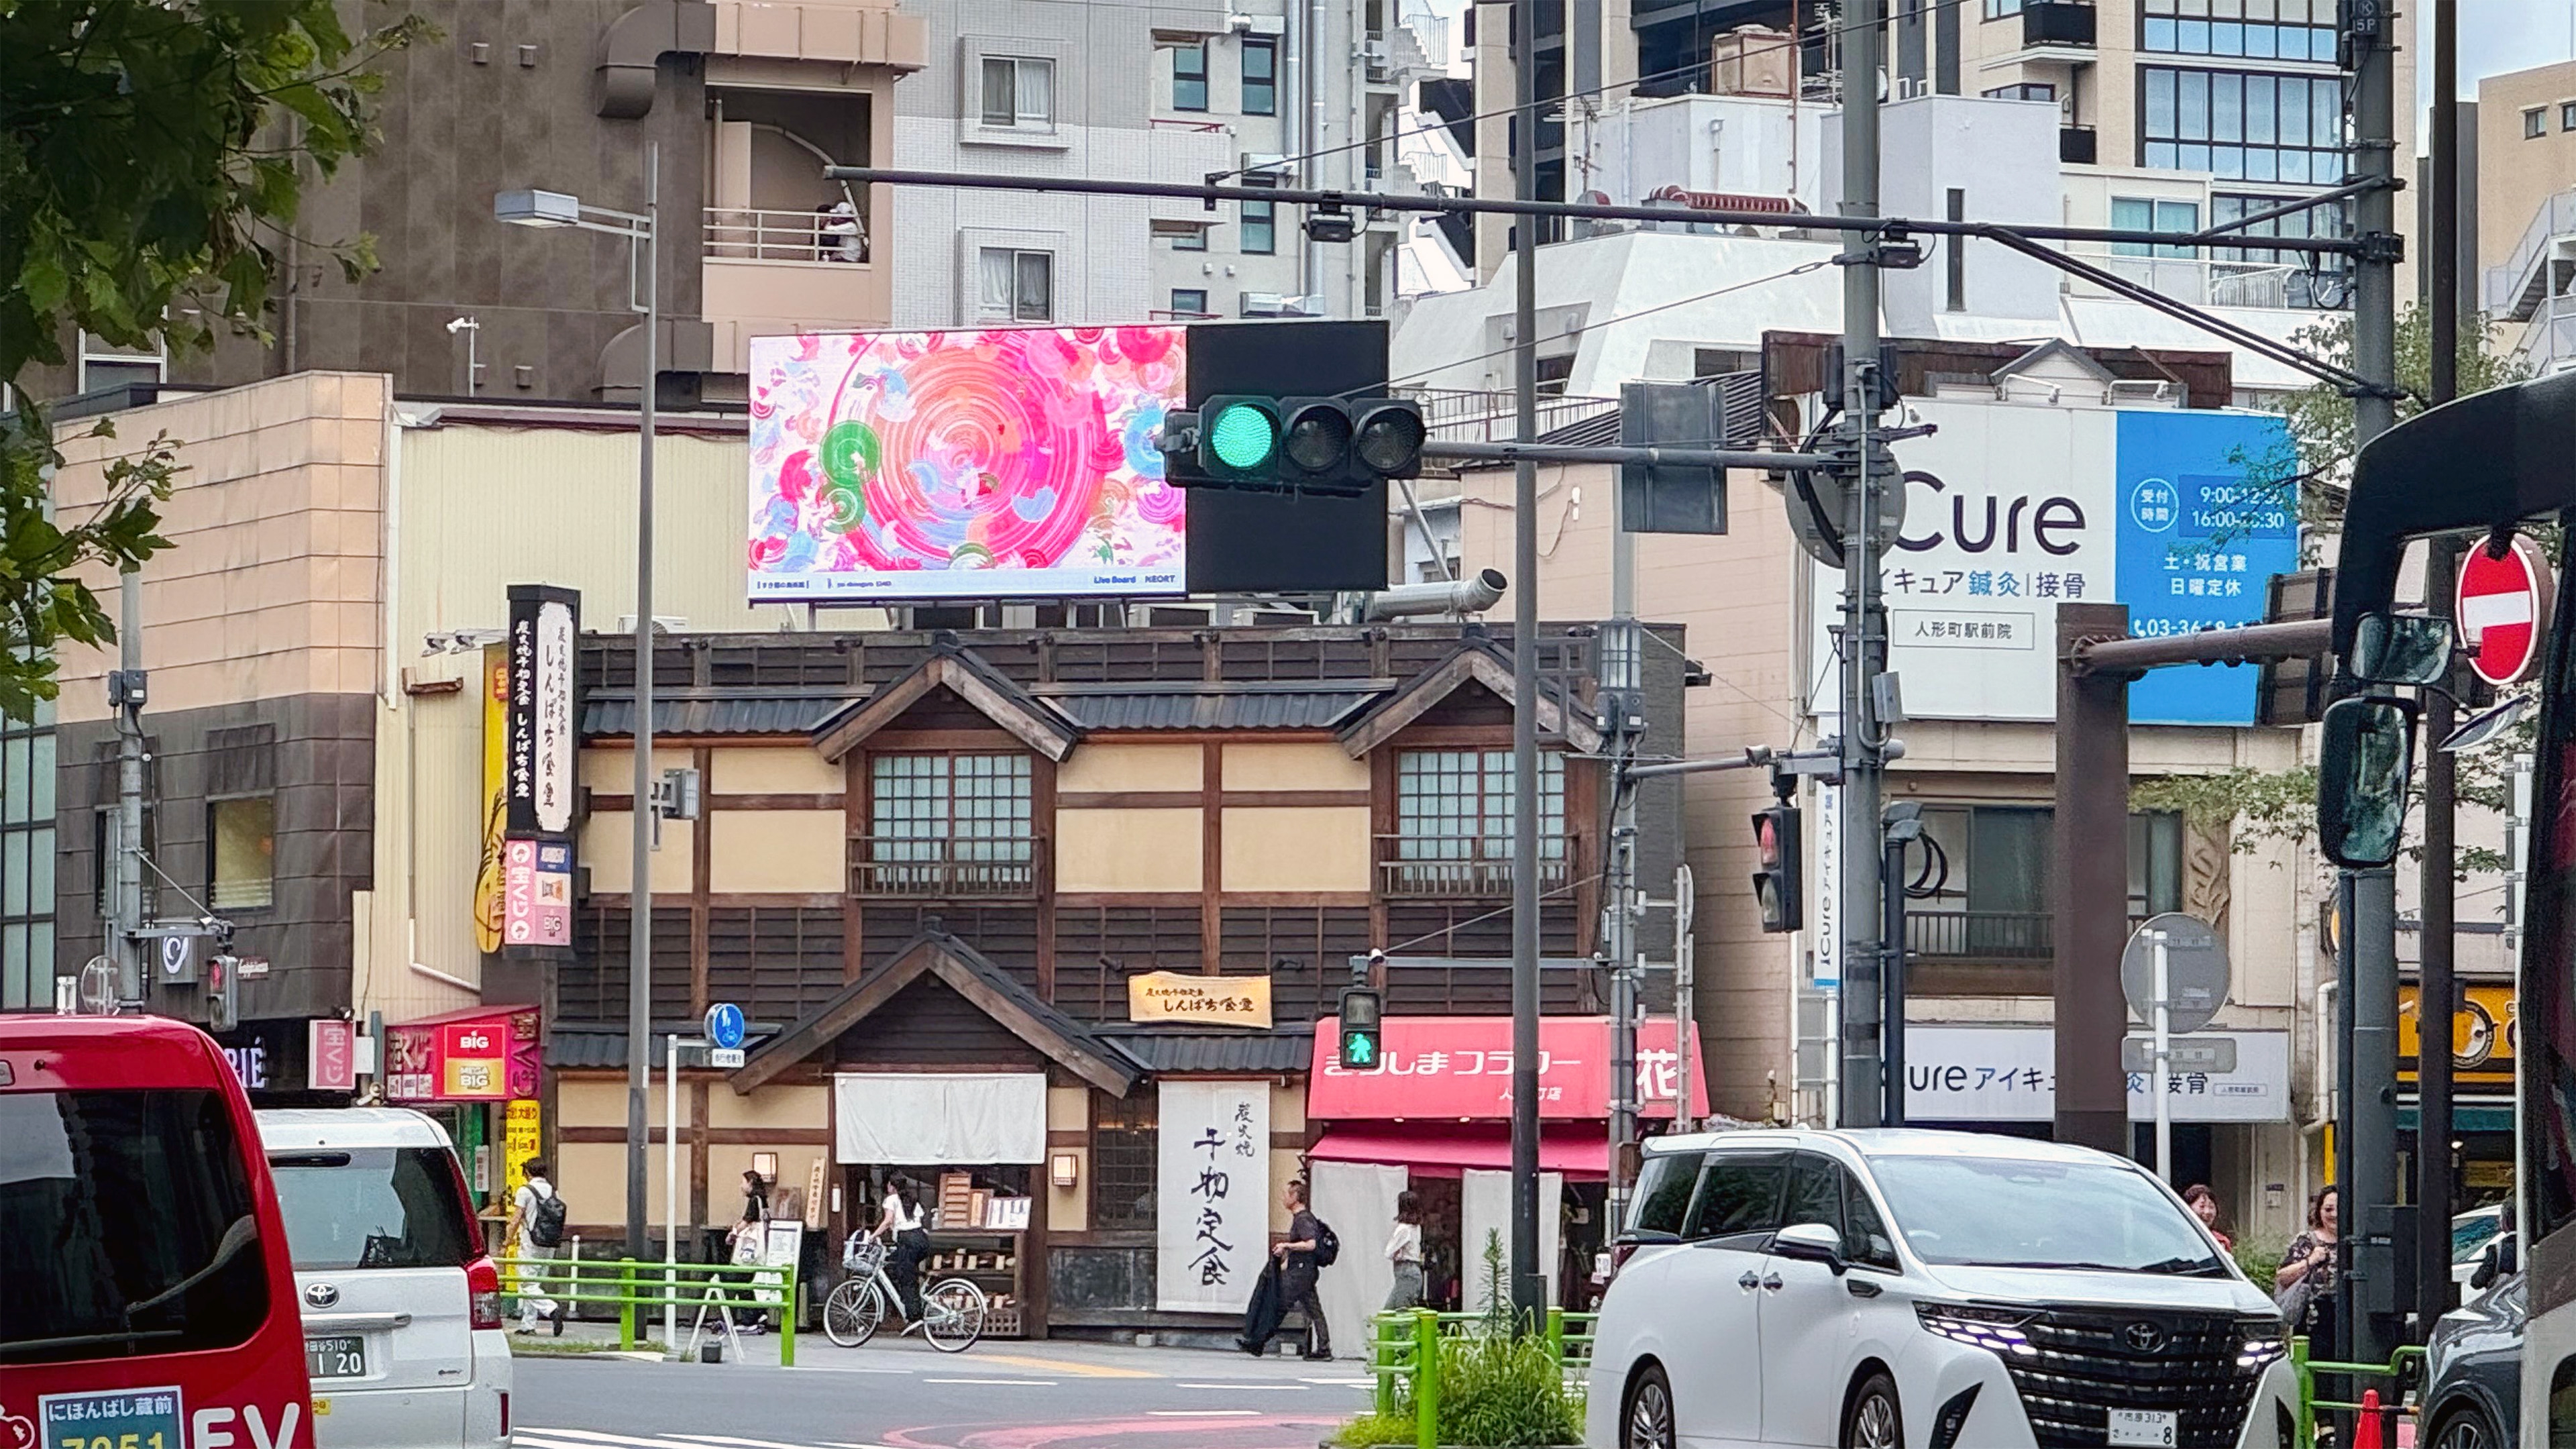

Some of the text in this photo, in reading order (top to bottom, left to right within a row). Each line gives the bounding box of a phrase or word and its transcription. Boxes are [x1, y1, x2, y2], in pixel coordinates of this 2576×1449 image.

[2141, 489, 2169, 504] 受付
[2141, 508, 2169, 522] 時間
[2171, 578, 2242, 596] 日曜定休
[1914, 620, 2012, 640] 人形町駅前院
[460, 1030, 490, 1049] BIG
[324, 1027, 346, 1084] 宝くじ
[460, 1075, 490, 1087] BIG
[1637, 1049, 1678, 1097] 花
[1187, 1127, 1234, 1286] 干物定食
[48, 1395, 173, 1421] にほんばし蔵前
